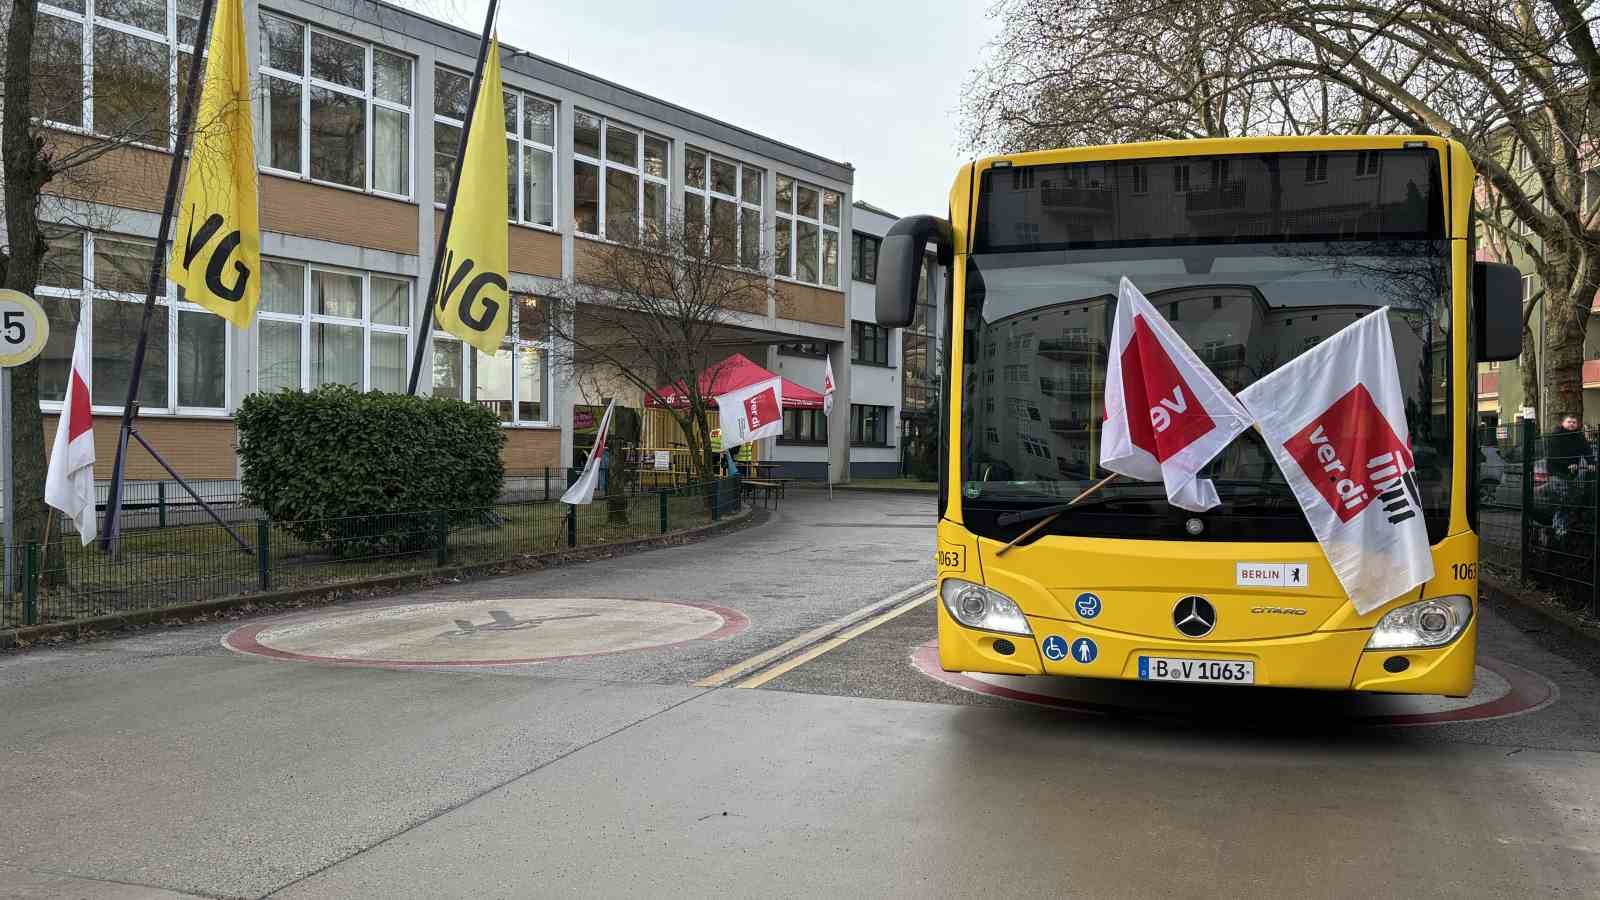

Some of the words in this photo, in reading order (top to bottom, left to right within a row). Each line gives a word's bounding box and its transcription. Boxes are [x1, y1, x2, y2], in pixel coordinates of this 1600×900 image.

[435, 247, 508, 332] VG
[1309, 424, 1369, 510] ver.di
[1241, 569, 1280, 579] BERLIN
[1157, 660, 1168, 677] B
[1181, 661, 1193, 679] V
[1198, 662, 1246, 680] 1063
